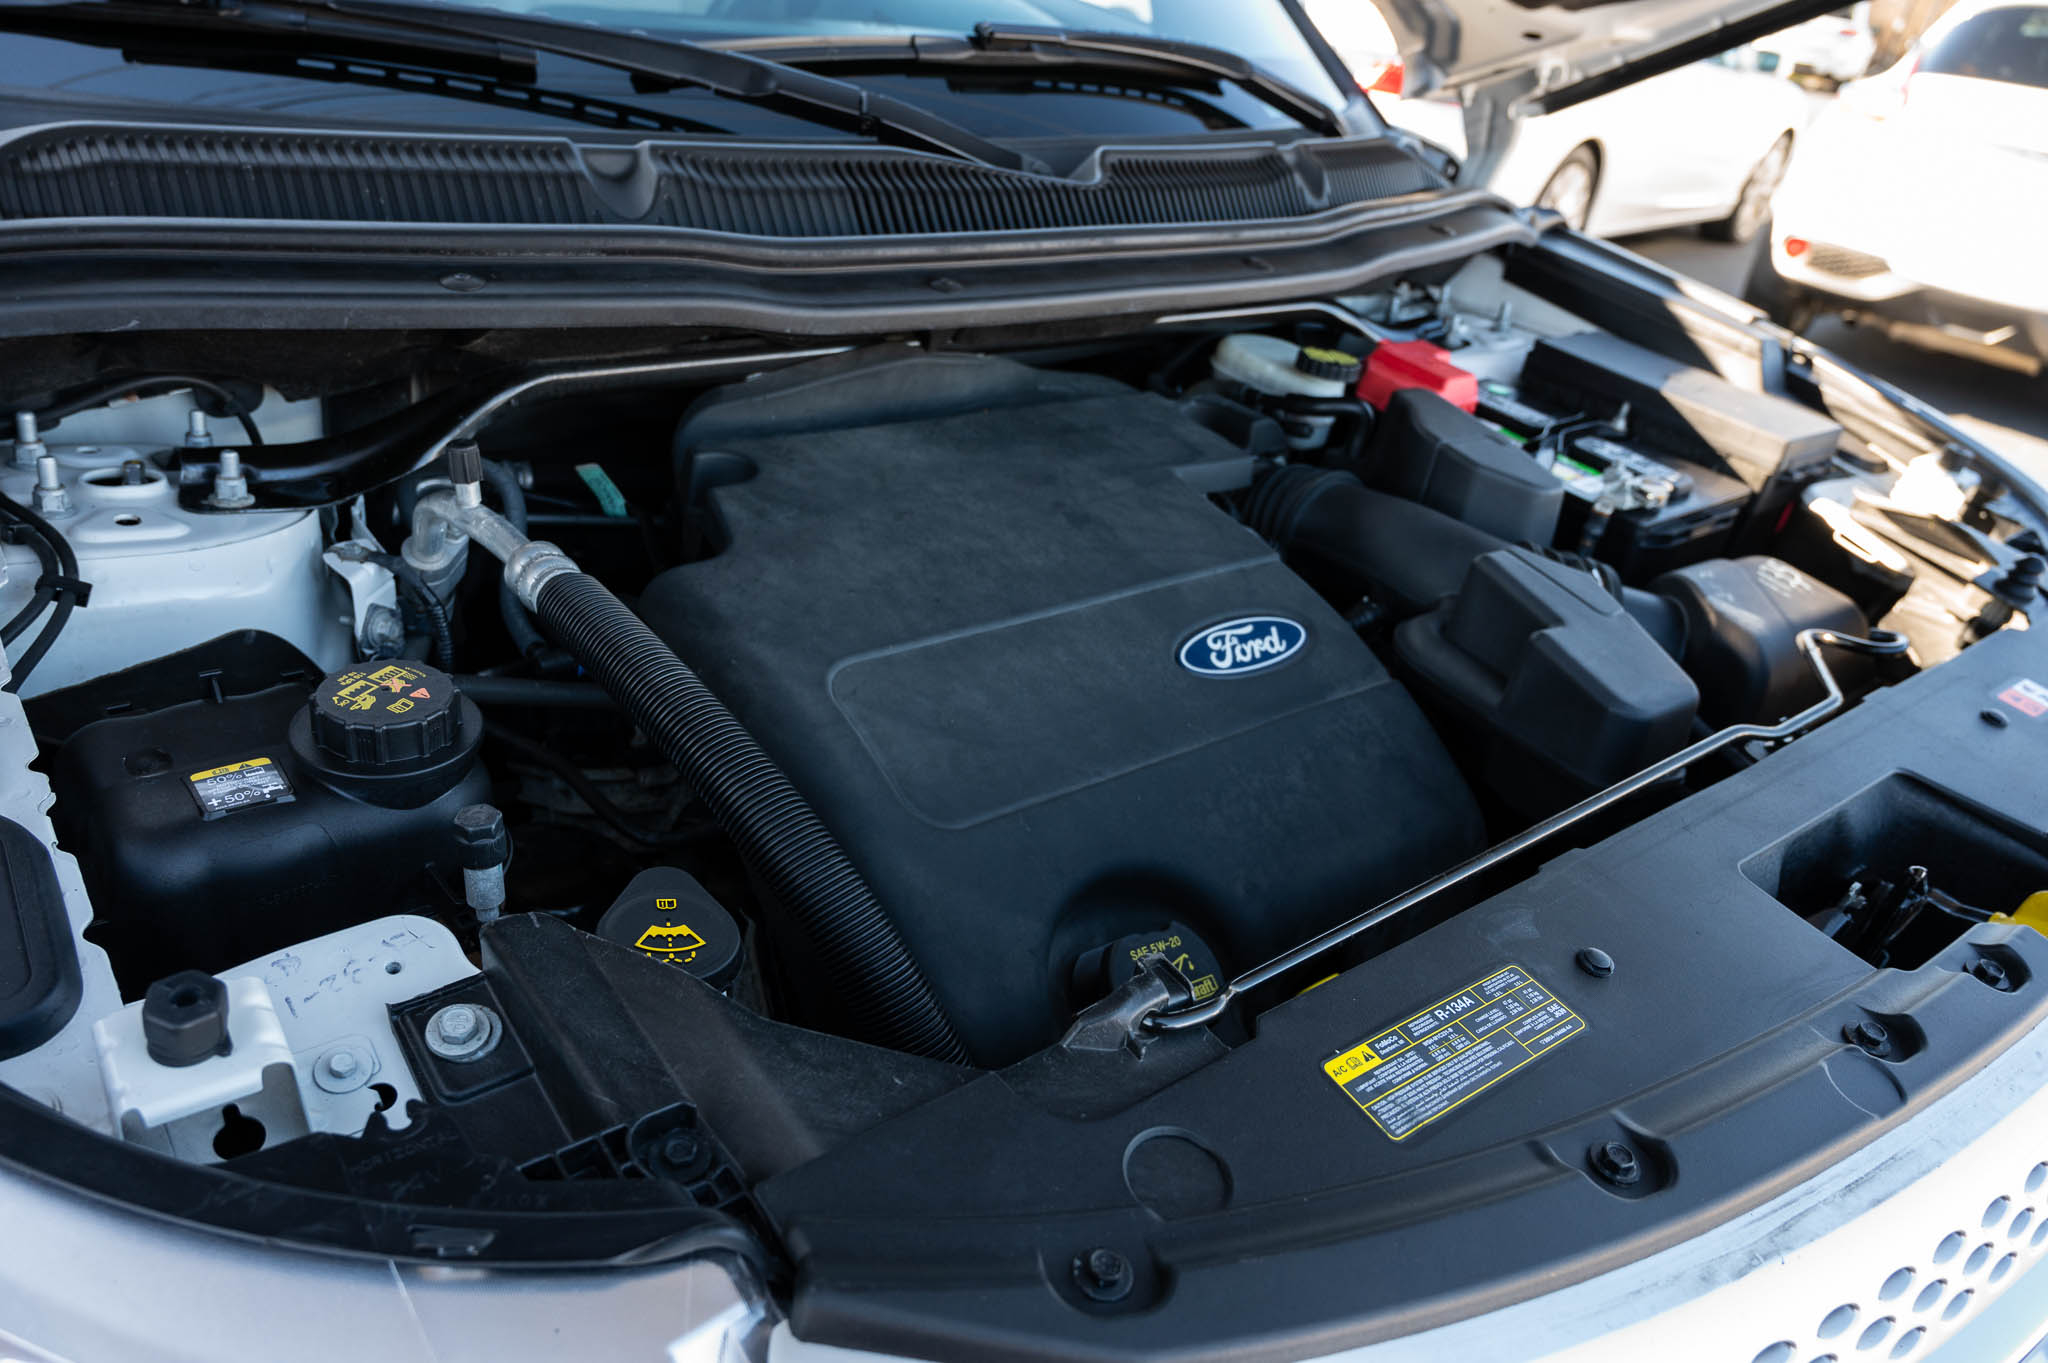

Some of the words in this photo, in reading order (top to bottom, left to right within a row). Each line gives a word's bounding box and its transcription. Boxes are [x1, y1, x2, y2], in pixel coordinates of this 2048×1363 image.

[1206, 624, 1287, 669] Ford
[207, 773, 243, 786] 50%
[1150, 936, 1182, 954] 5W-20
[1433, 995, 1475, 1020] R-134A
[1375, 1035, 1399, 1049] FoMoCo
[1331, 1065, 1348, 1077] A/C
